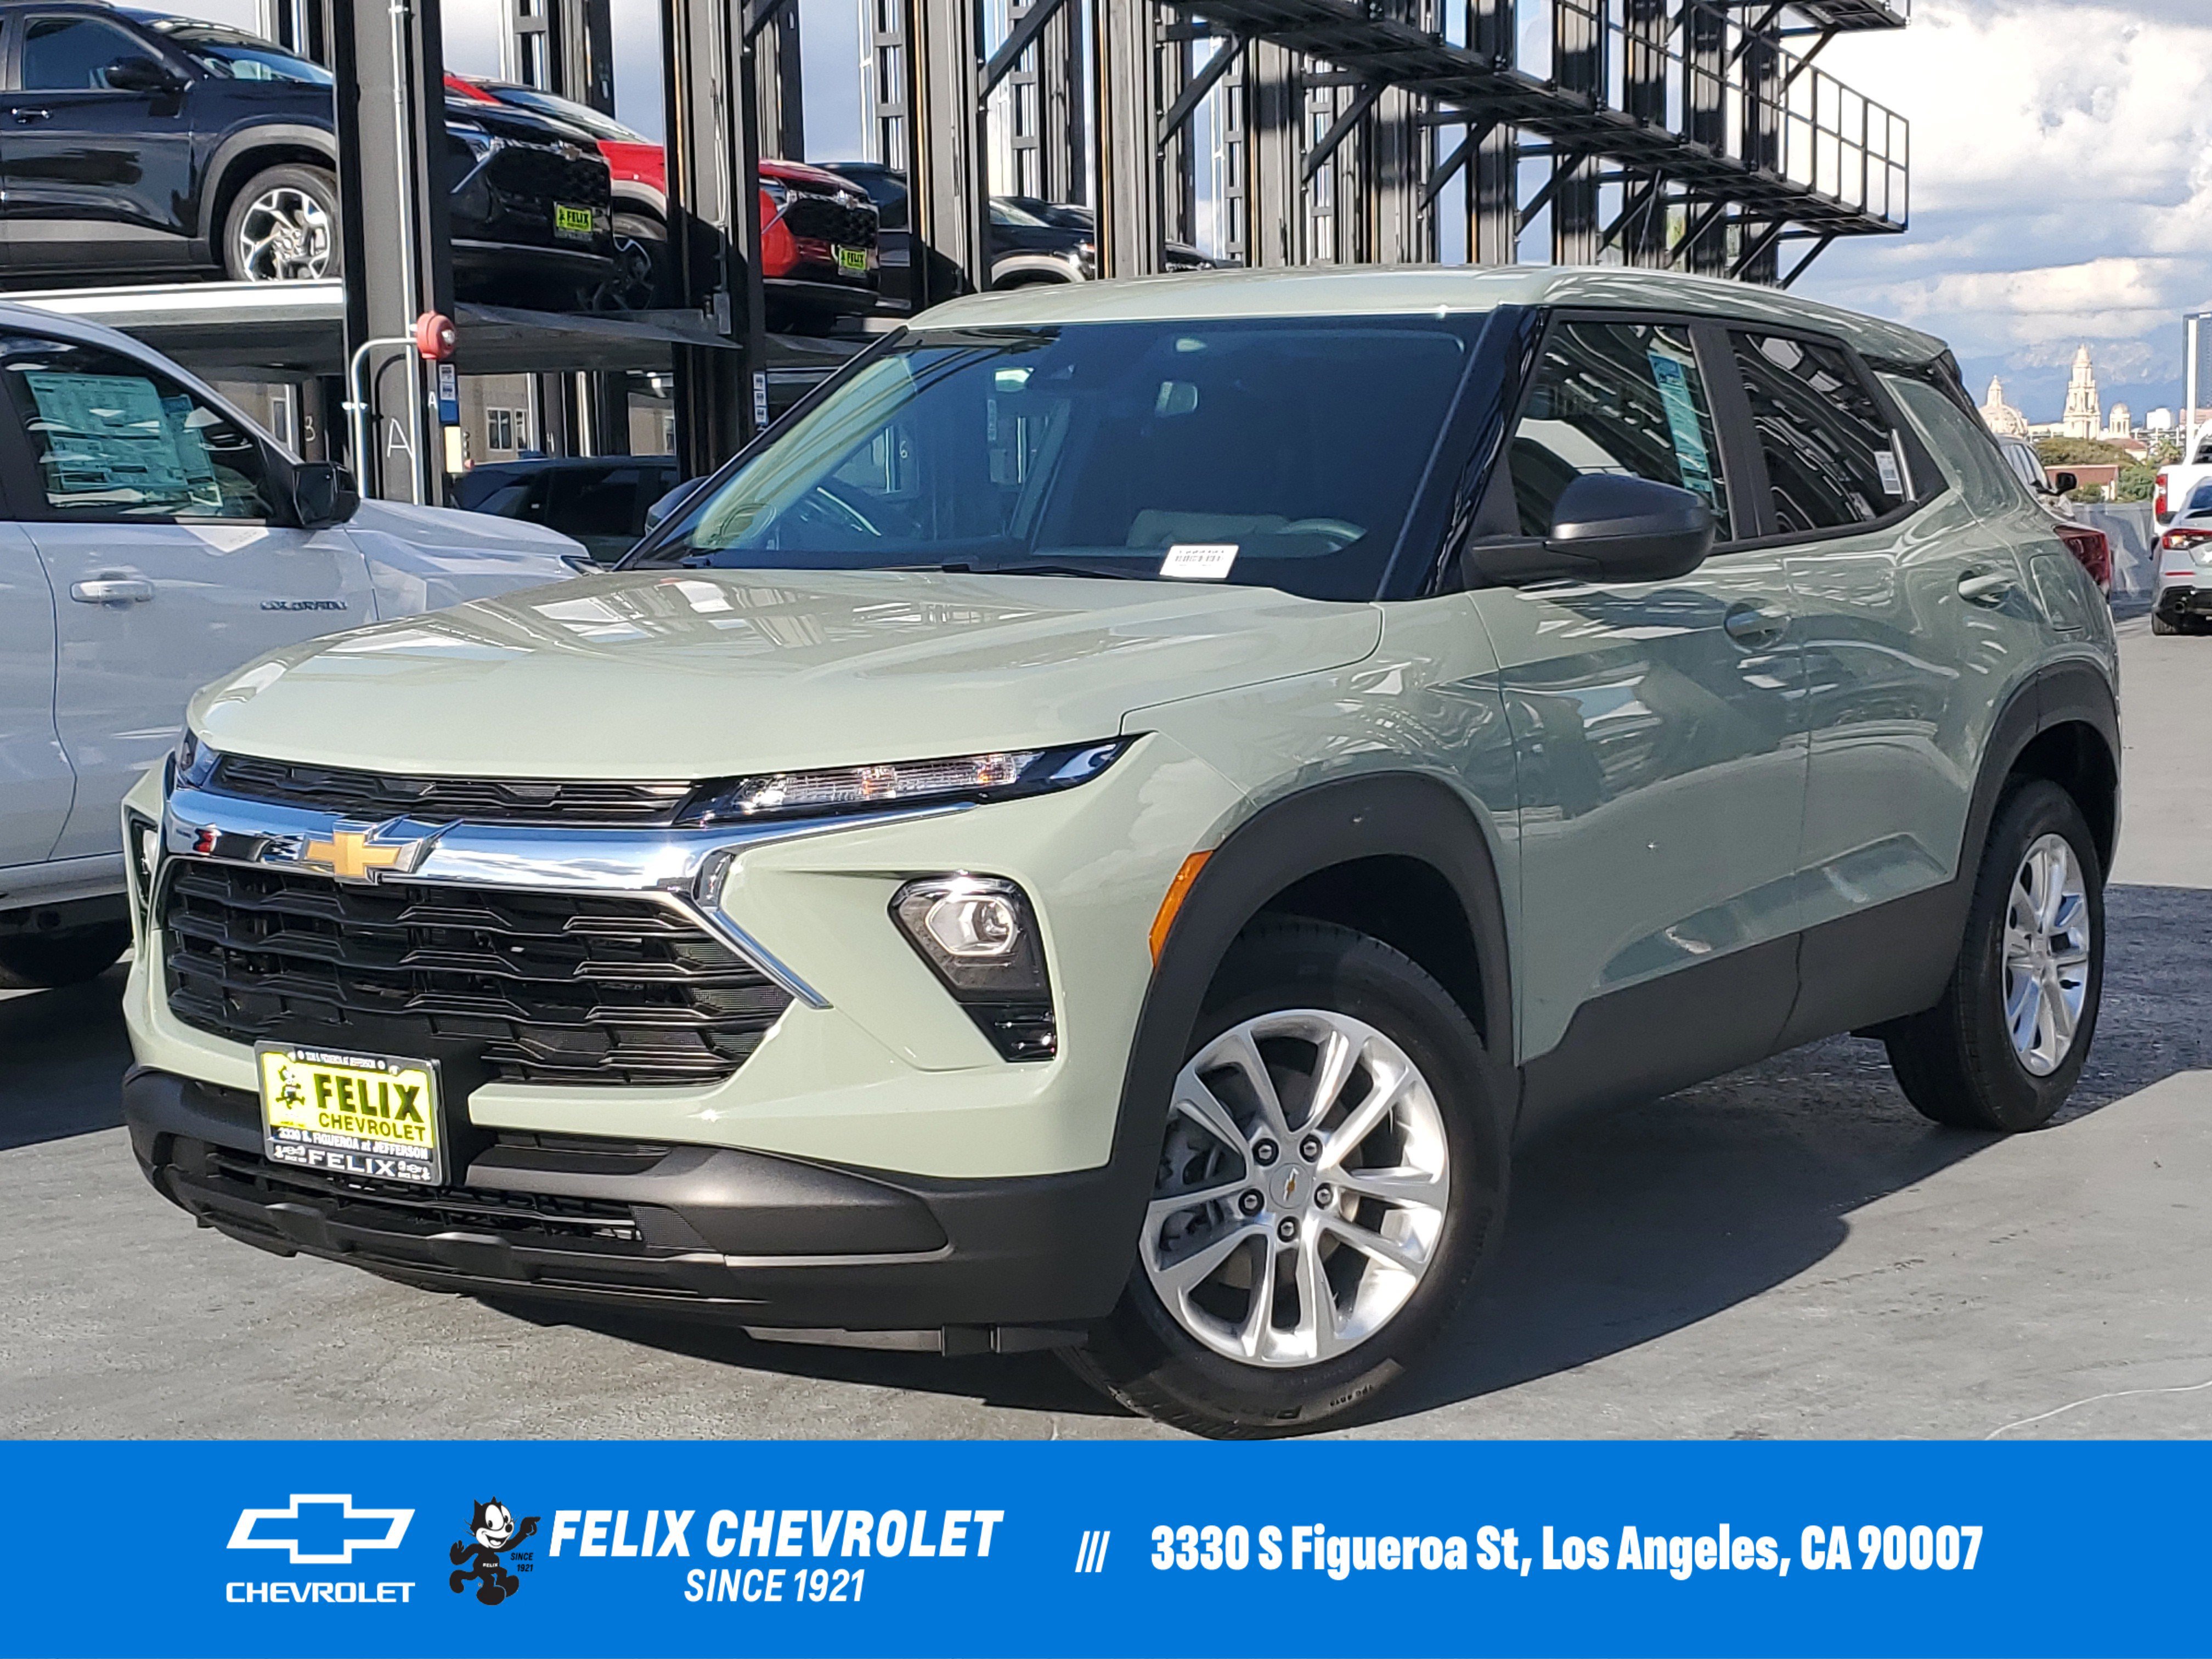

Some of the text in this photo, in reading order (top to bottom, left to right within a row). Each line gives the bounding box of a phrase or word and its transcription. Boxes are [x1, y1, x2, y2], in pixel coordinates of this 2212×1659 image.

[567, 210, 589, 225] FELIX
[428, 391, 438, 410] A
[387, 417, 413, 459] A
[313, 1073, 425, 1123] FELIX
[319, 1113, 426, 1142] CHEVROLET
[308, 1149, 396, 1177] FELIX
[373, 1141, 428, 1160] JEFFERSON
